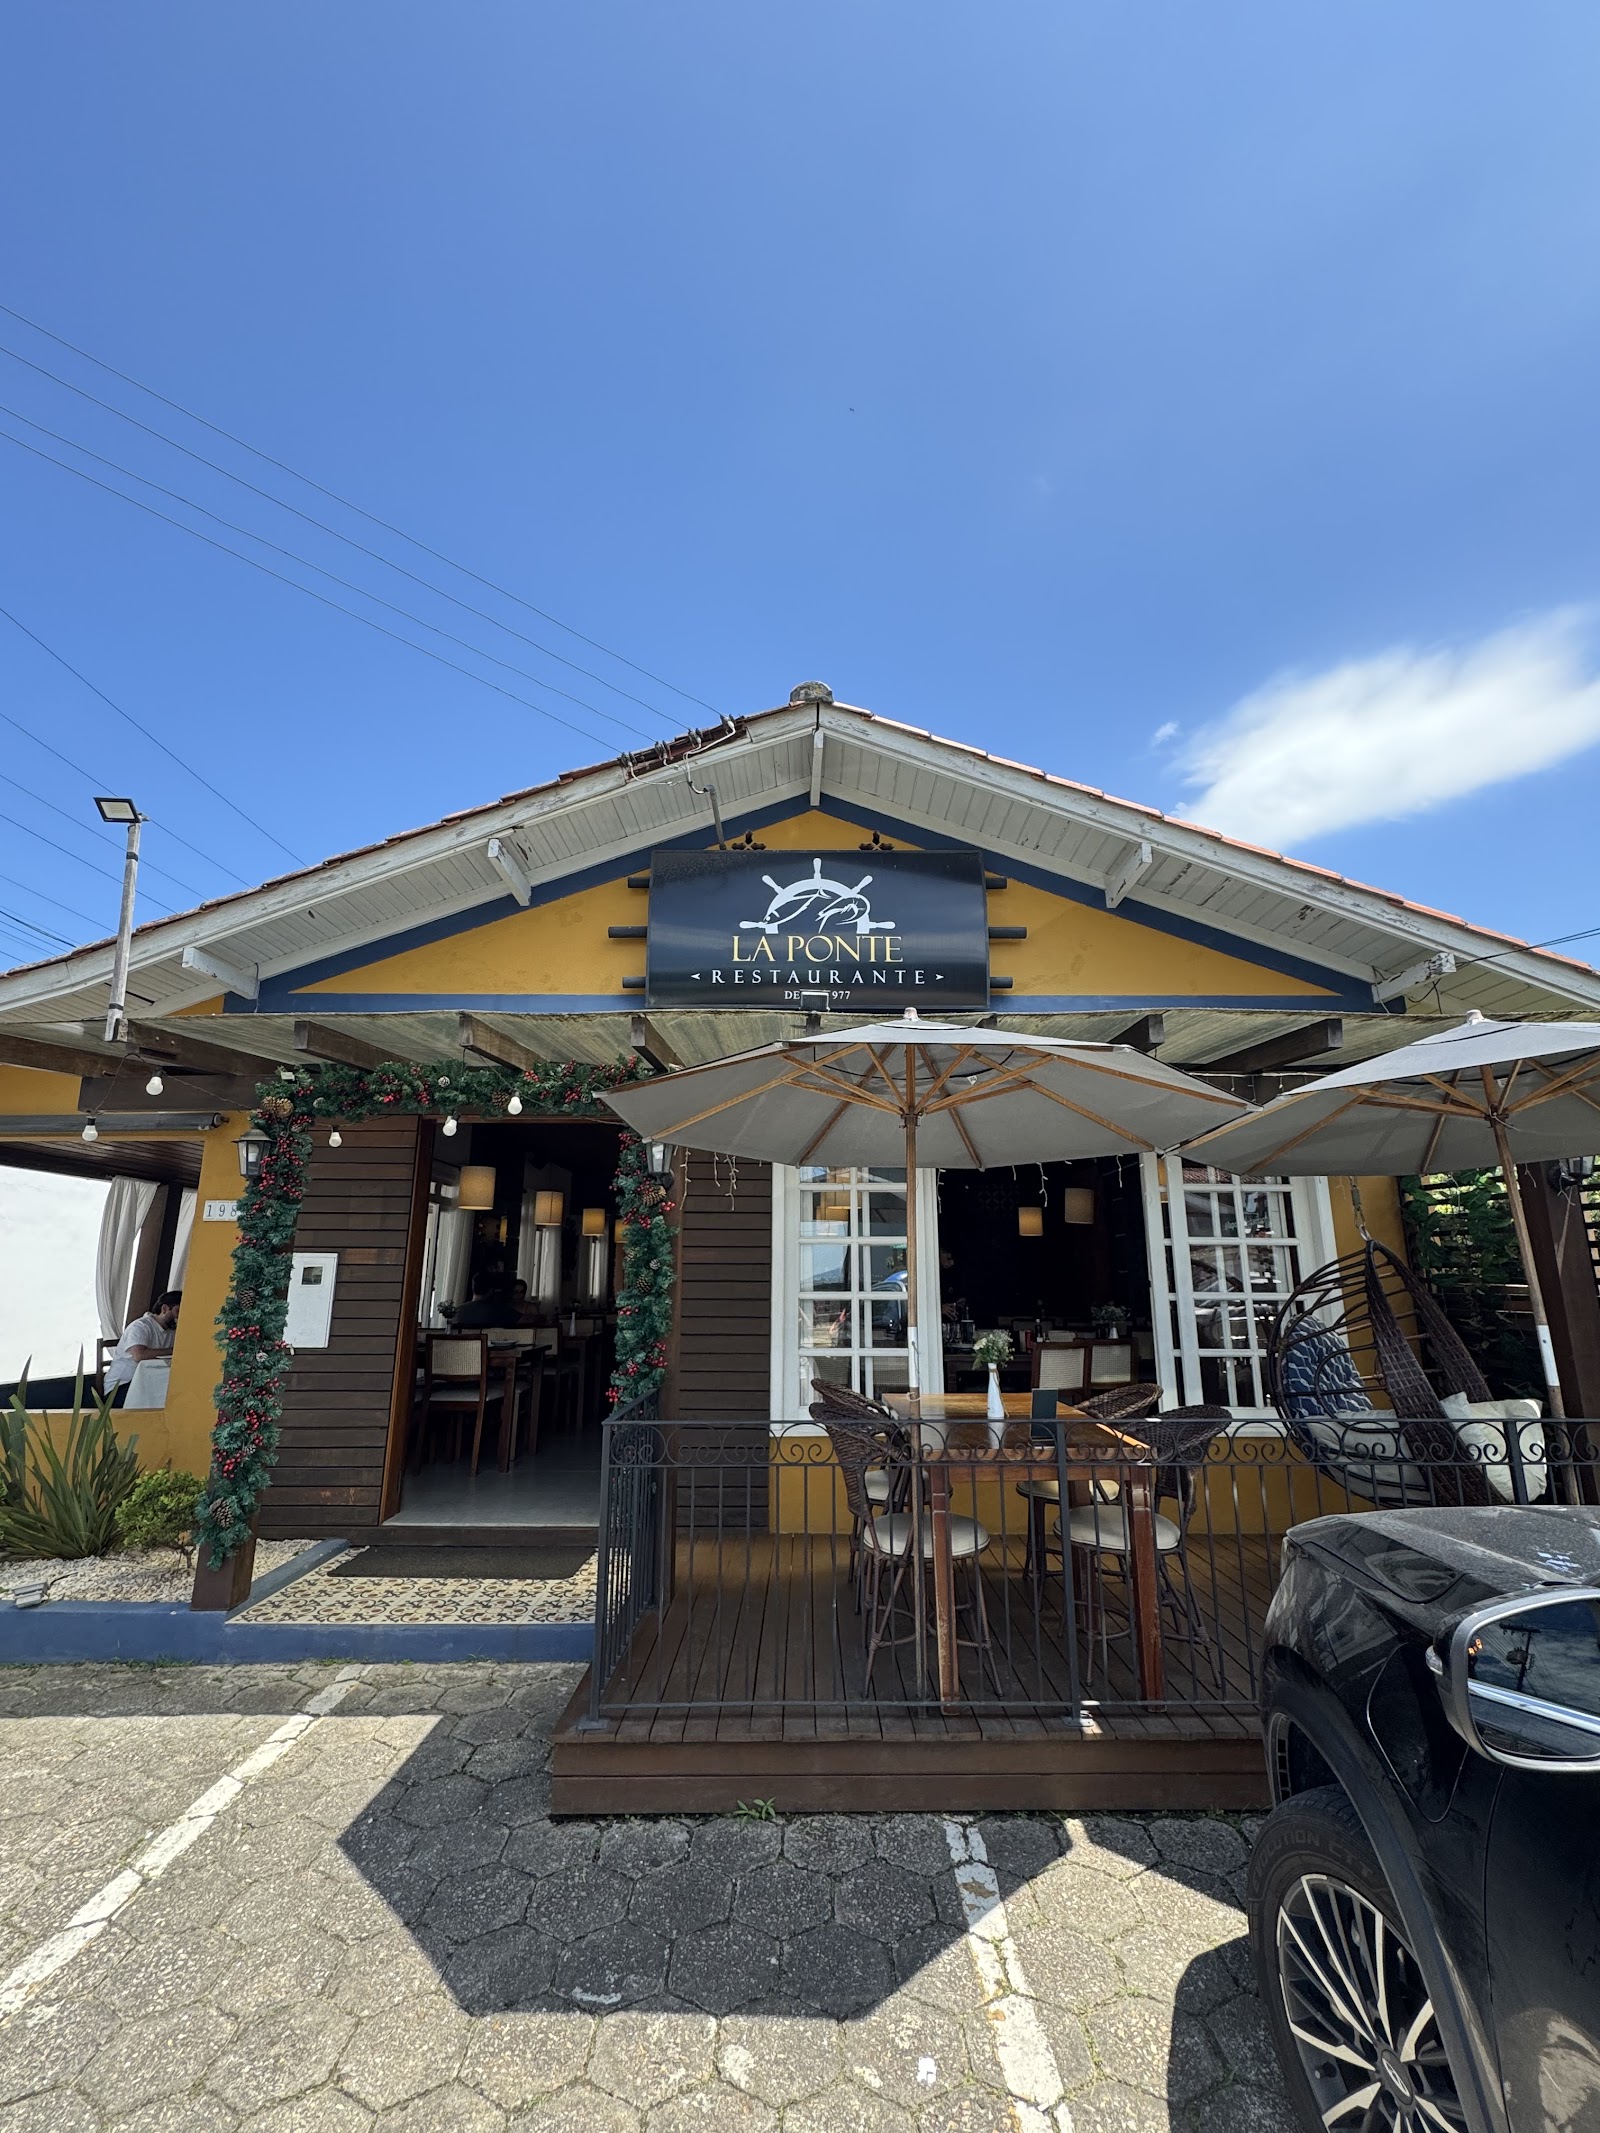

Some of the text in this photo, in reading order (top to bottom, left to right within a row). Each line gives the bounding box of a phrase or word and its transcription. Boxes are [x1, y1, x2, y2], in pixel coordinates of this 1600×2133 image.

[732, 935, 903, 962] LA PONTE
[711, 970, 926, 984] RESTAURANTE
[831, 990, 850, 1000] 977
[206, 1204, 237, 1217] 198
